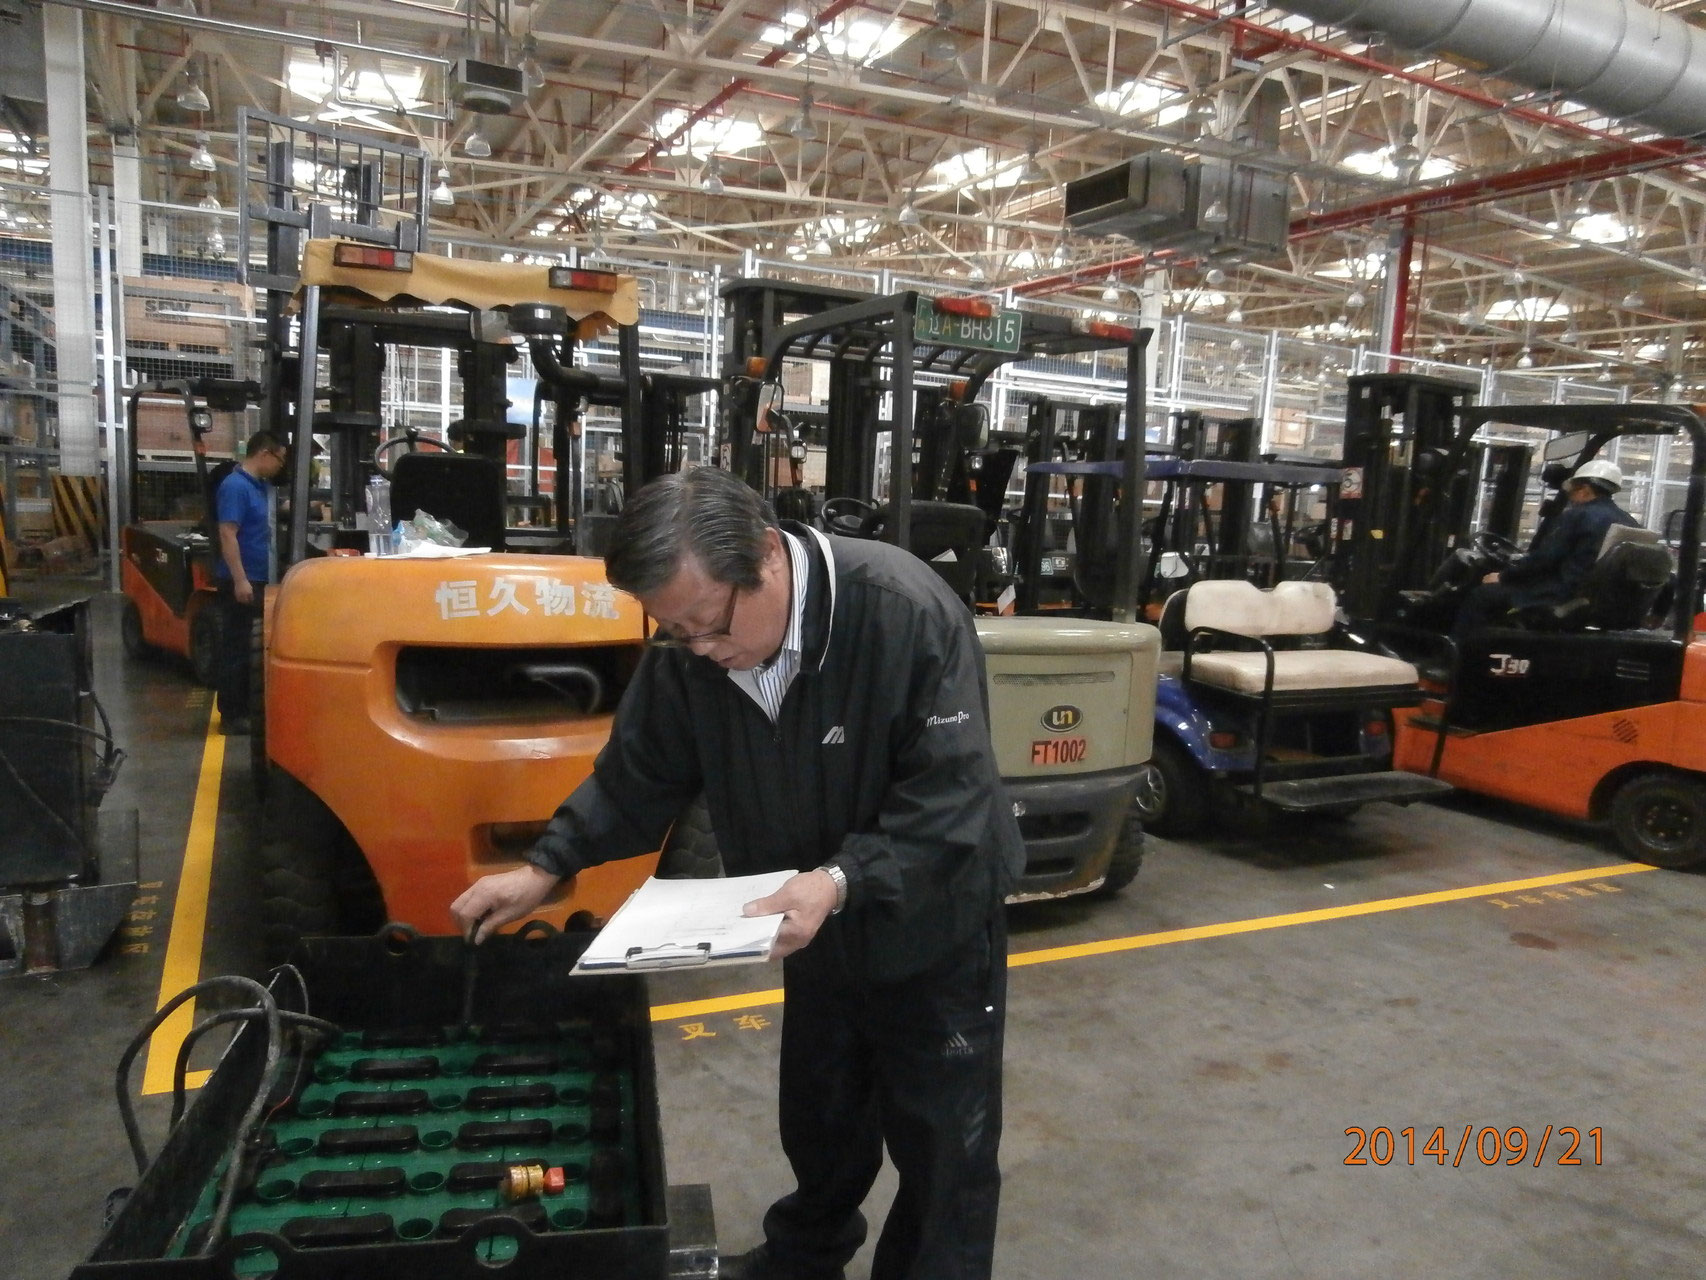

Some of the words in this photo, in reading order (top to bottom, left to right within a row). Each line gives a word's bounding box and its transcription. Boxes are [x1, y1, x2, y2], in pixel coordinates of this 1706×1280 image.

[434, 577, 620, 620] 恒久物流
[1031, 739, 1087, 764] FT1002
